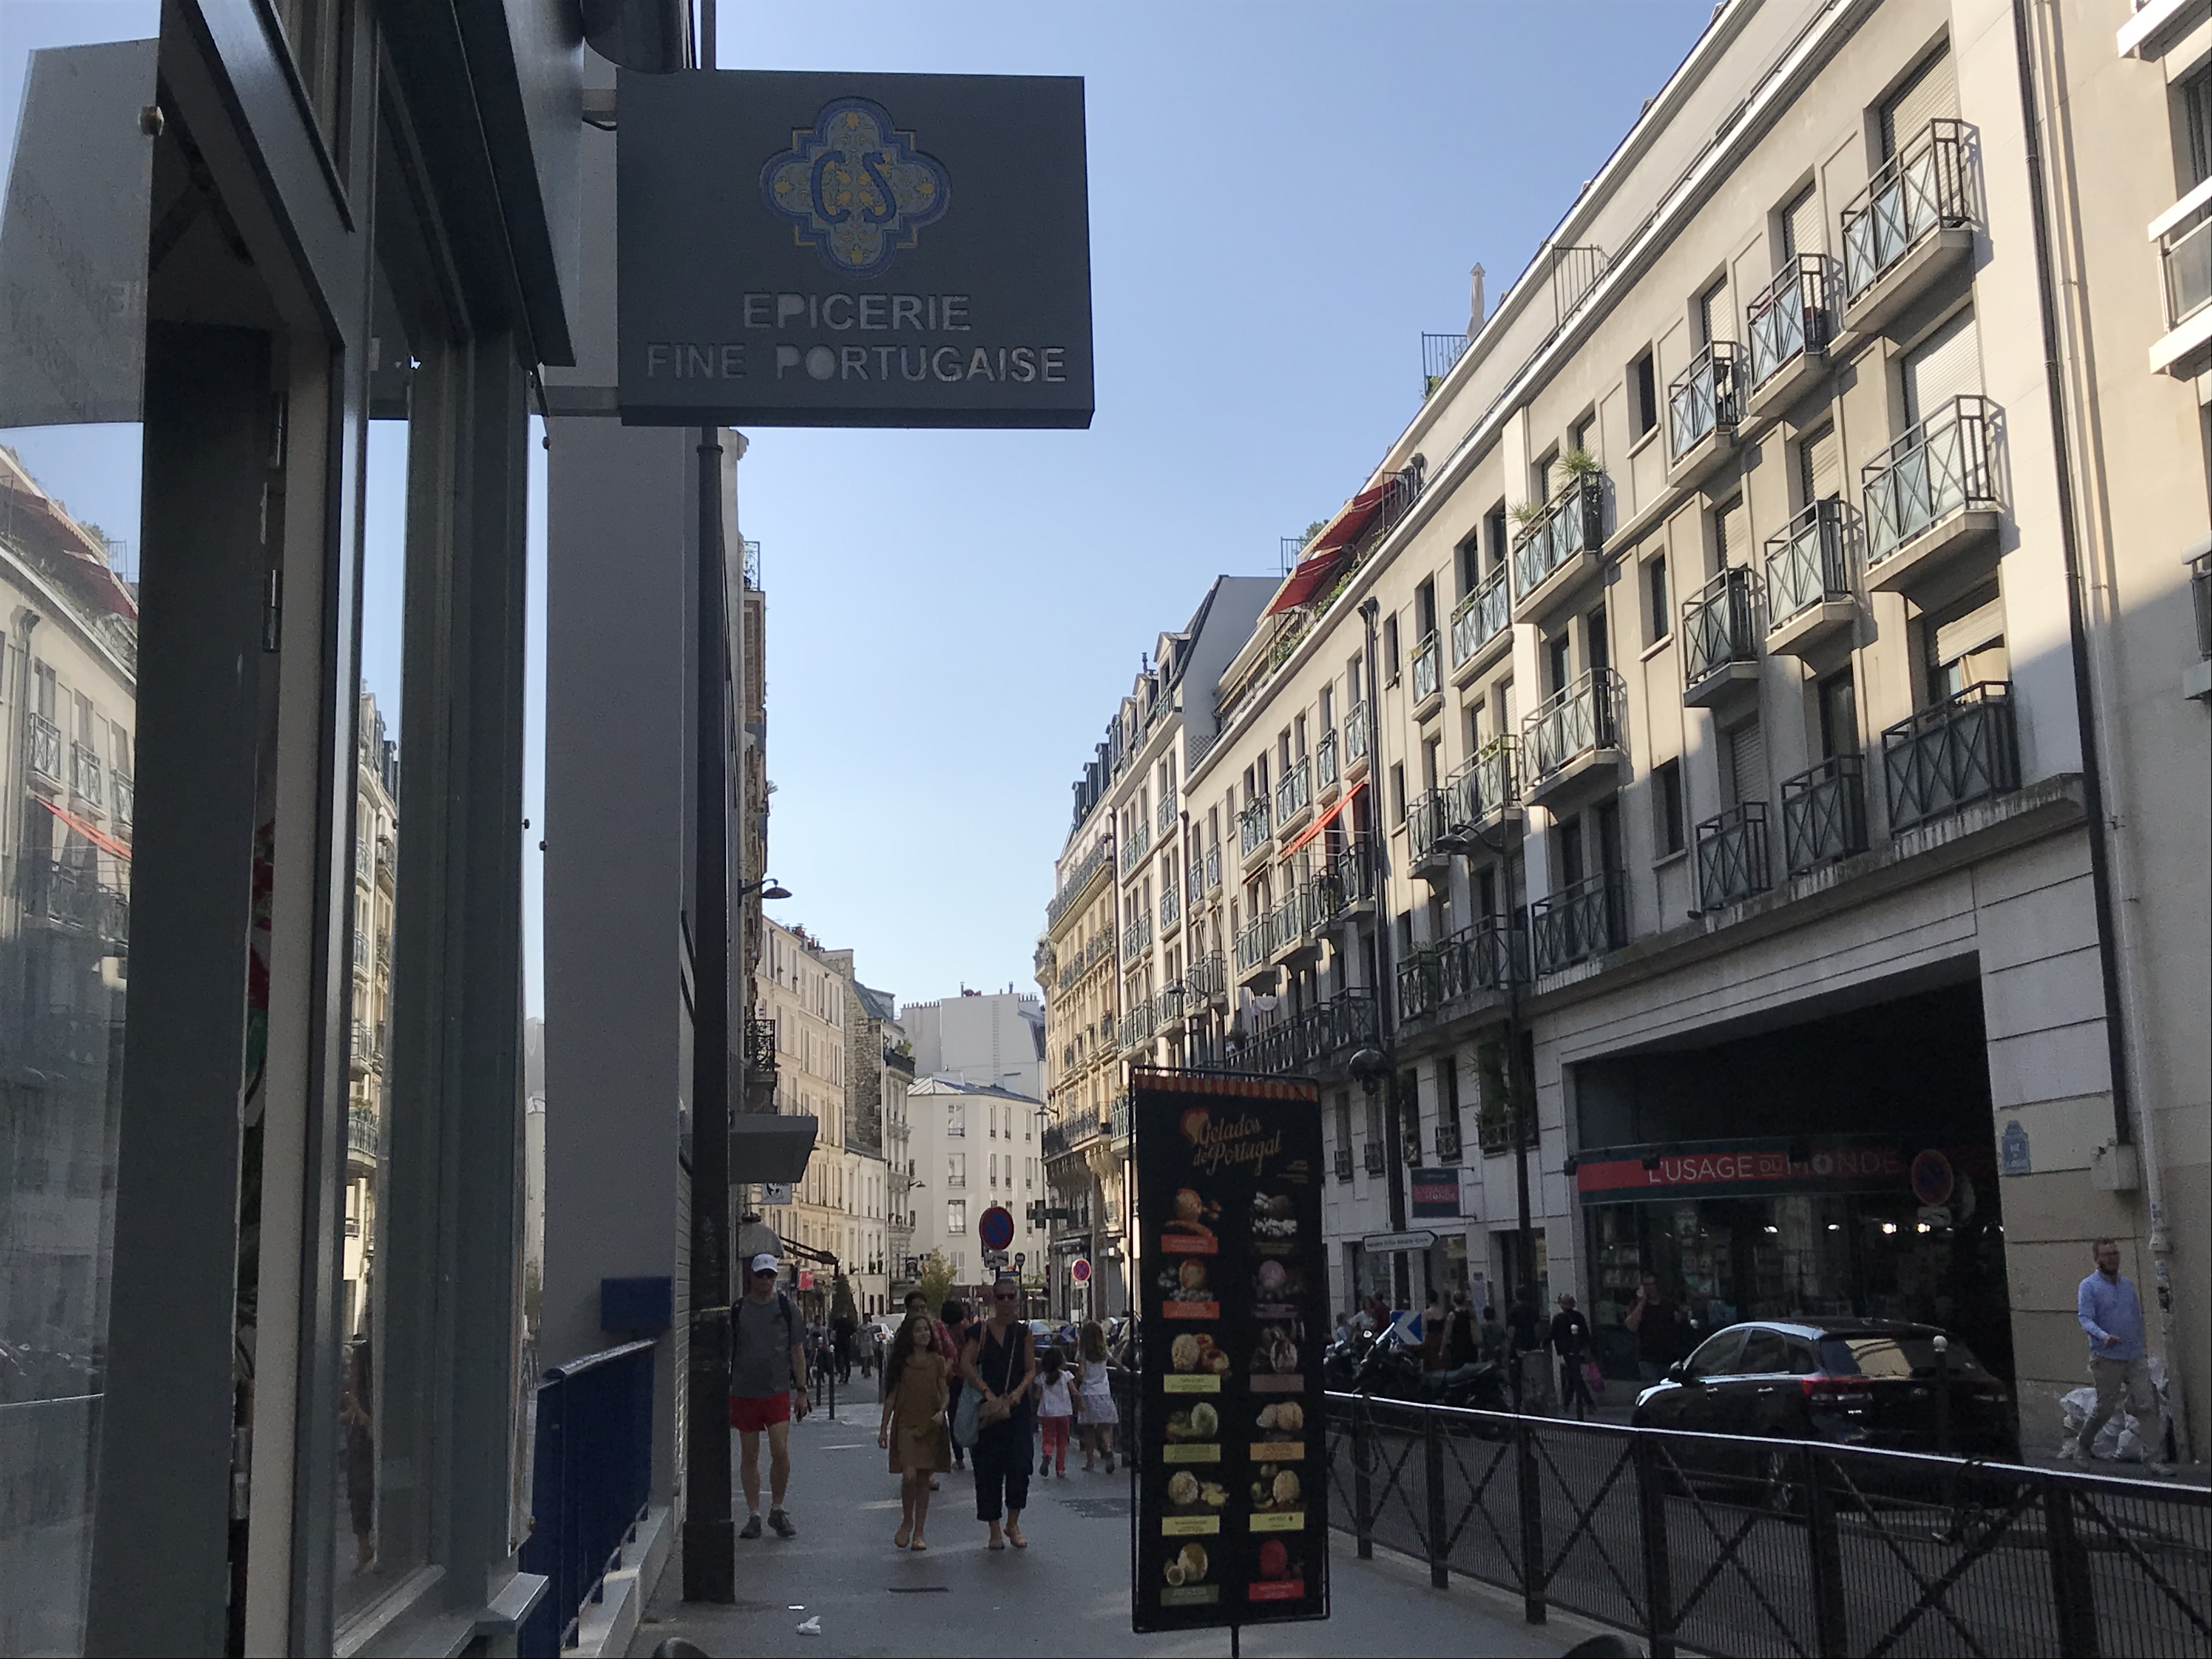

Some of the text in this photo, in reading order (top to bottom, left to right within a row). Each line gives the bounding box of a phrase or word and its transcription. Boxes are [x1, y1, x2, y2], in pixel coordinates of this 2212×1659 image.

[744, 292, 972, 330] EPICERIE
[646, 342, 1067, 383] FINE PORTUGAISE
[1199, 1113, 1261, 1147] Gelados
[1206, 1128, 1281, 1177] Portugal
